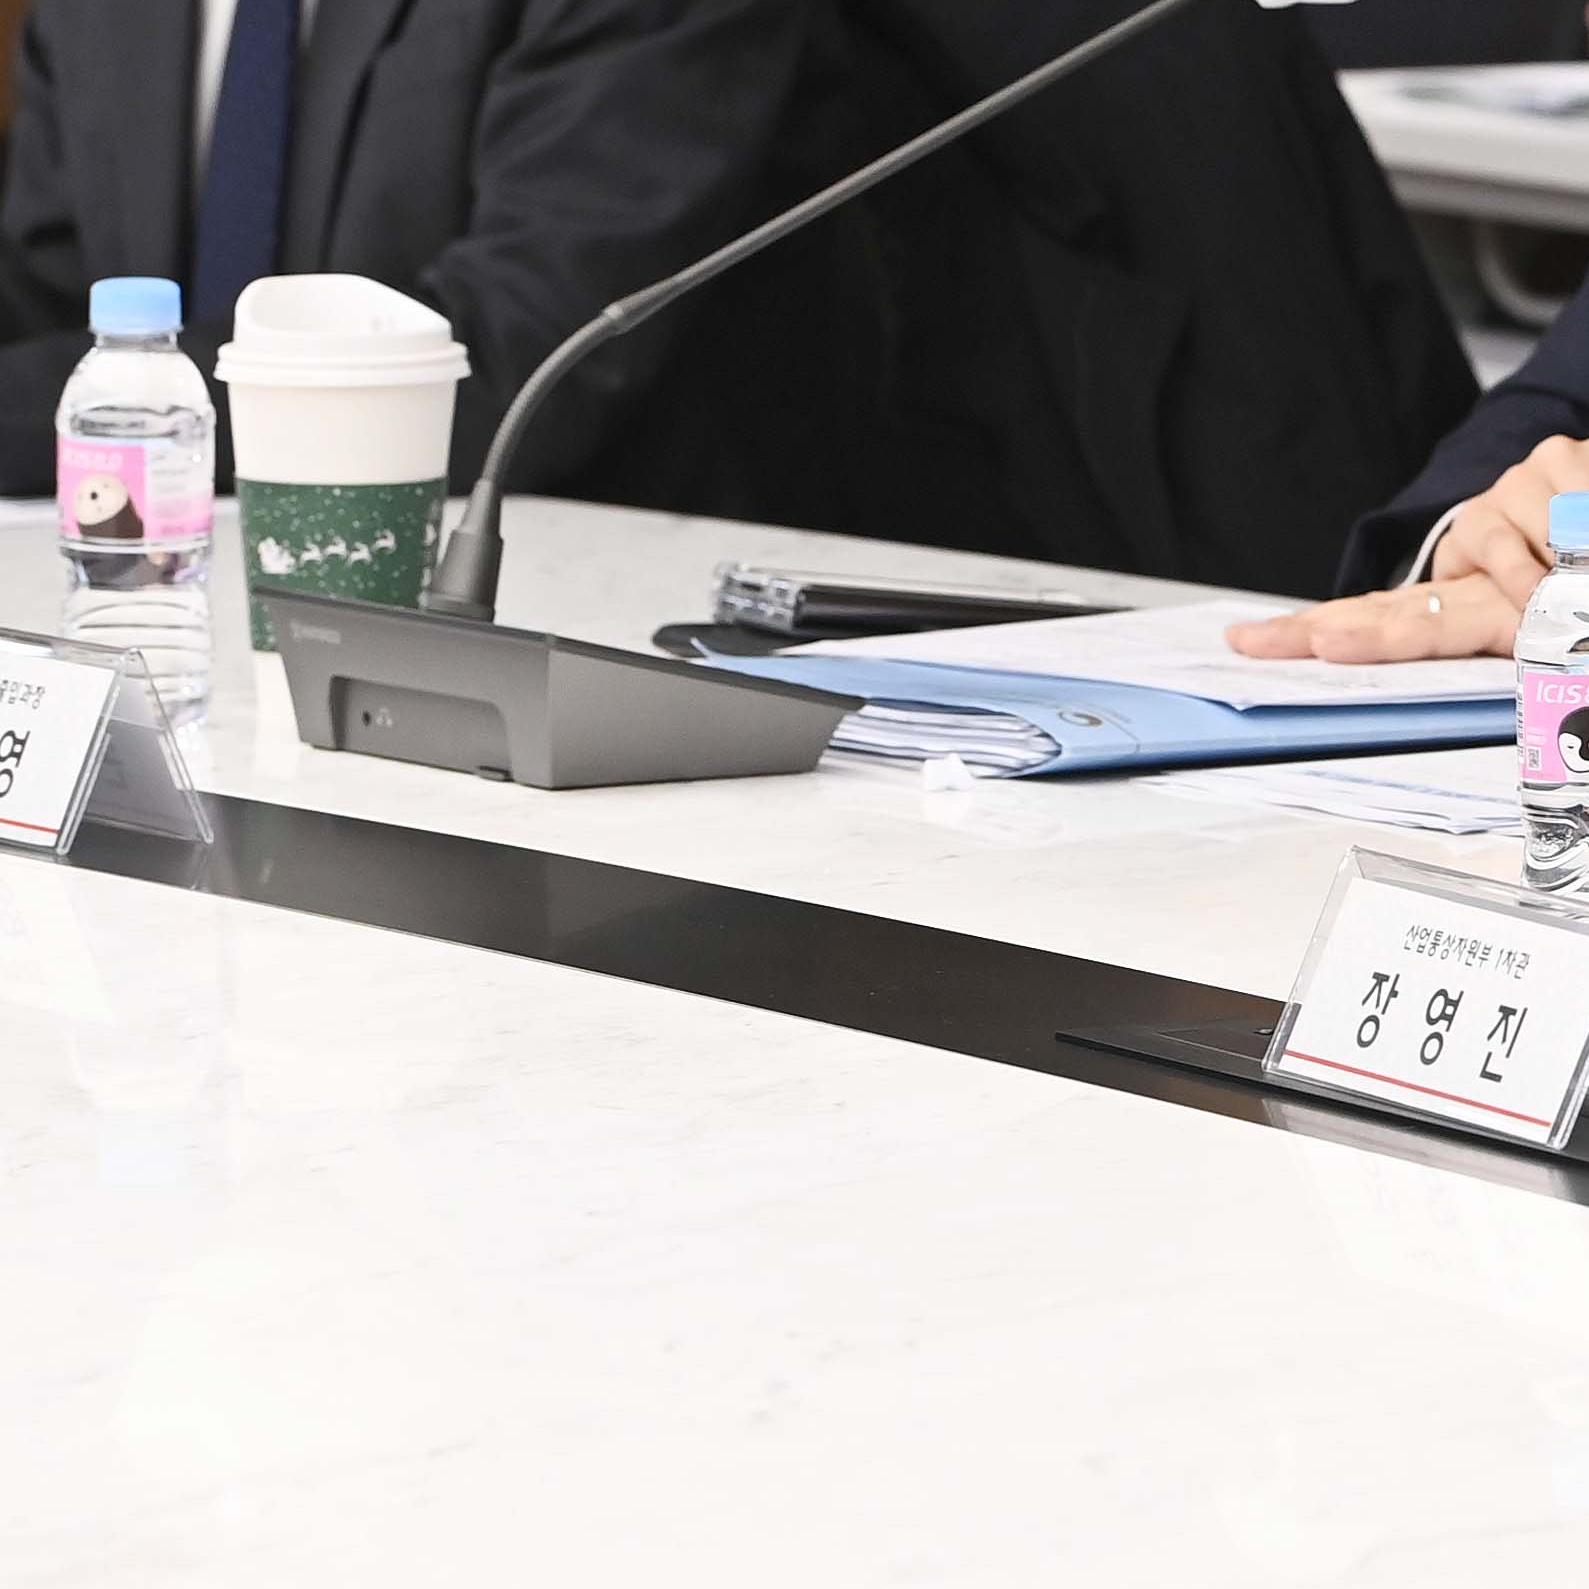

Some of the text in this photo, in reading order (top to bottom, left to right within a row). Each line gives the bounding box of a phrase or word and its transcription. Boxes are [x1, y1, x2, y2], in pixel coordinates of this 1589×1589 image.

[1403, 925, 1530, 979] 산업통상자원부 1차관
[1356, 971, 1528, 1083] 장 영 진
